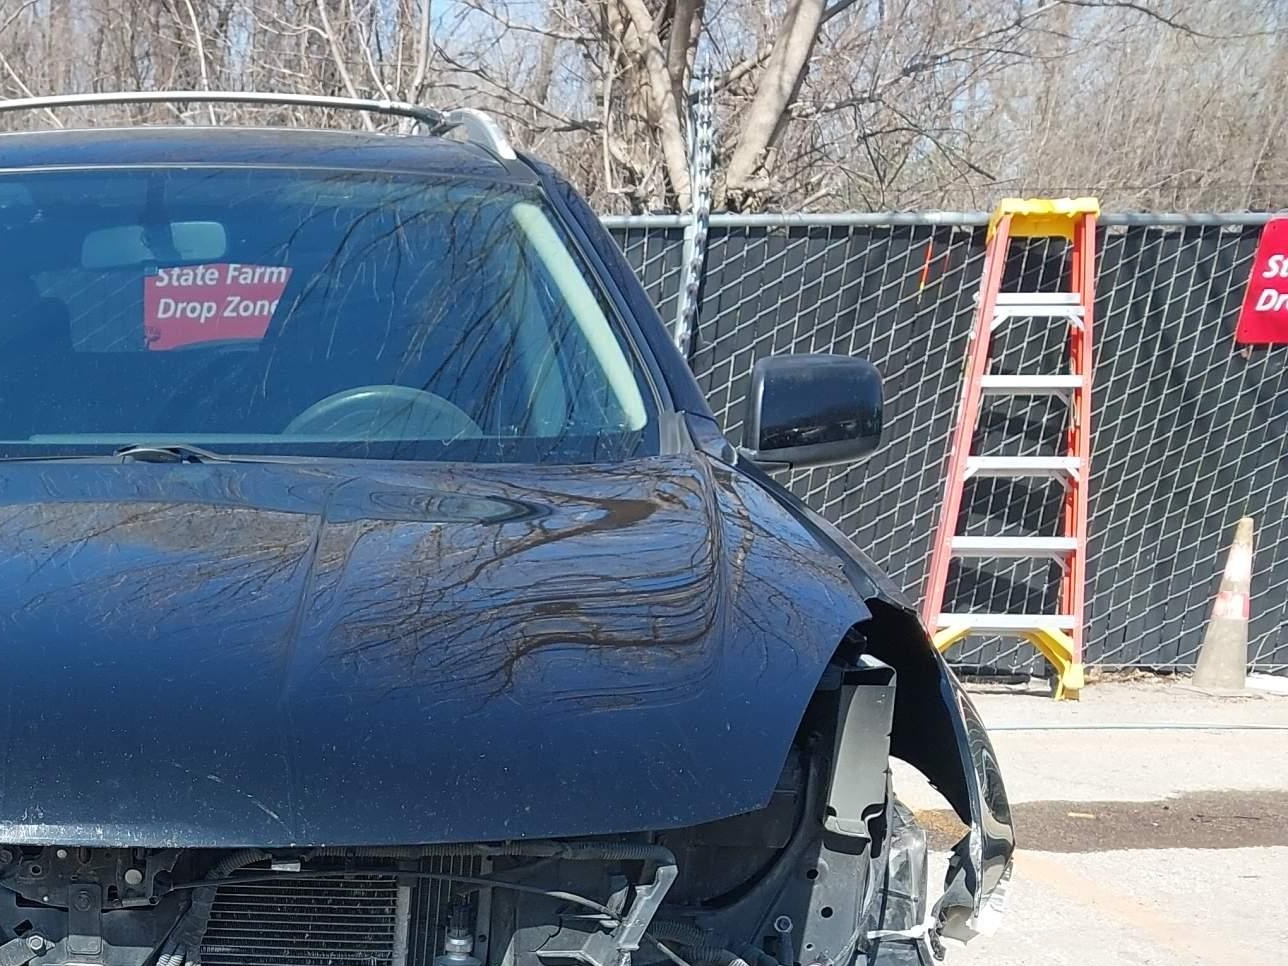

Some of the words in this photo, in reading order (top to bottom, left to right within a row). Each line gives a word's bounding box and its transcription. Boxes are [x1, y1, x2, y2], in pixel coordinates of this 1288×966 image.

[155, 265, 219, 287] State
[226, 263, 287, 285] Farm
[157, 298, 218, 324] Drop
[1255, 288, 1288, 311] Dr
